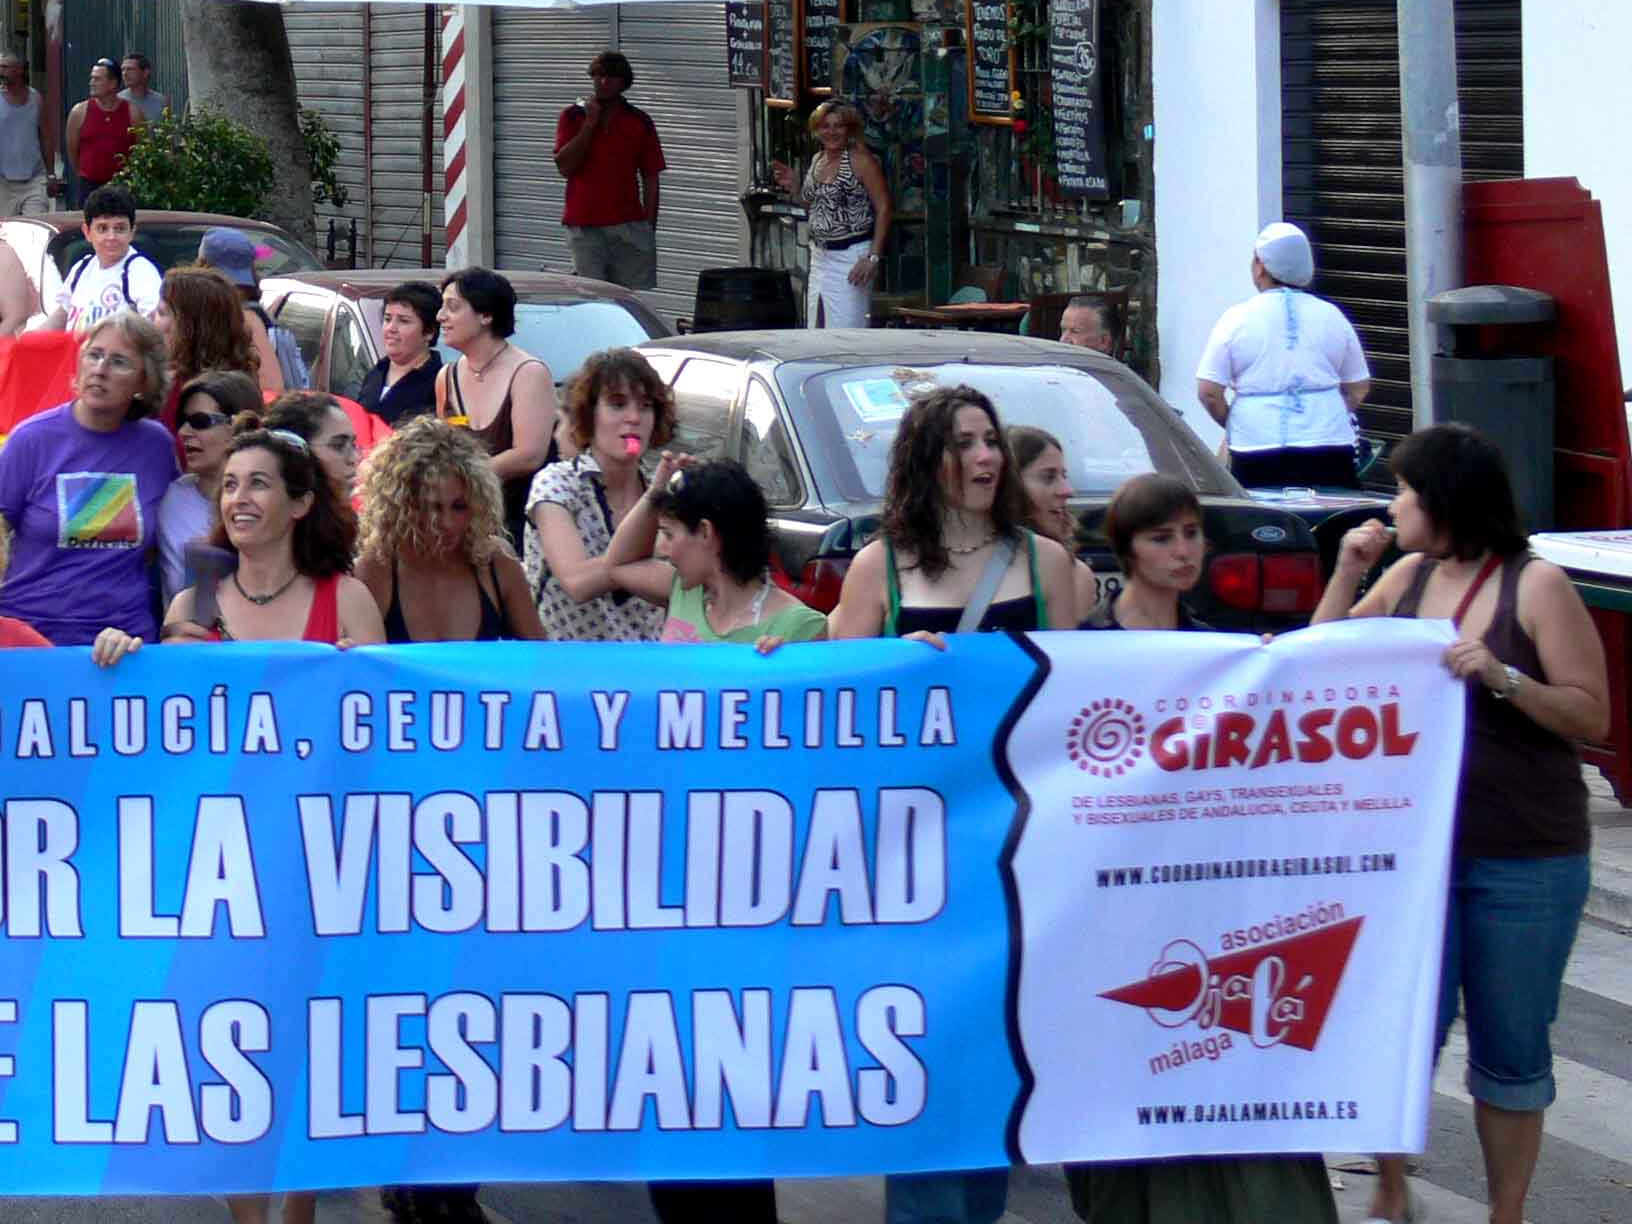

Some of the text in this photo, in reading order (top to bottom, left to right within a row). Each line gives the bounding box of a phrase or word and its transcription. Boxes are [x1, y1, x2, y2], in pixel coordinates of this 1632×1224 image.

[1155, 685, 1402, 714] COORDINADORA
[340, 688, 564, 754] CEUTA
[591, 690, 630, 751] Y
[656, 686, 958, 752] MELILLA
[1071, 795, 1095, 809] DE
[1230, 783, 1345, 800] TRANSEXUALES
[1072, 812, 1082, 825] Y
[1087, 808, 1176, 825] BISEXUALES
[1178, 807, 1200, 821] DE
[1290, 799, 1338, 814] CEUTA
[1339, 799, 1349, 812] Y
[1353, 796, 1413, 812] MELILLA
[116, 792, 268, 938] LA
[296, 786, 949, 937] VISIBILIDAD
[1095, 853, 1398, 888] WWW.COORDINADORAGIRASOL.COM
[1221, 899, 1346, 951] asociación
[52, 998, 275, 1145] LAS
[306, 983, 928, 1140] LESBIANAS
[1148, 1031, 1234, 1076] málaga
[1136, 1100, 1359, 1126] WWW.OJALAMALAGA.ES
